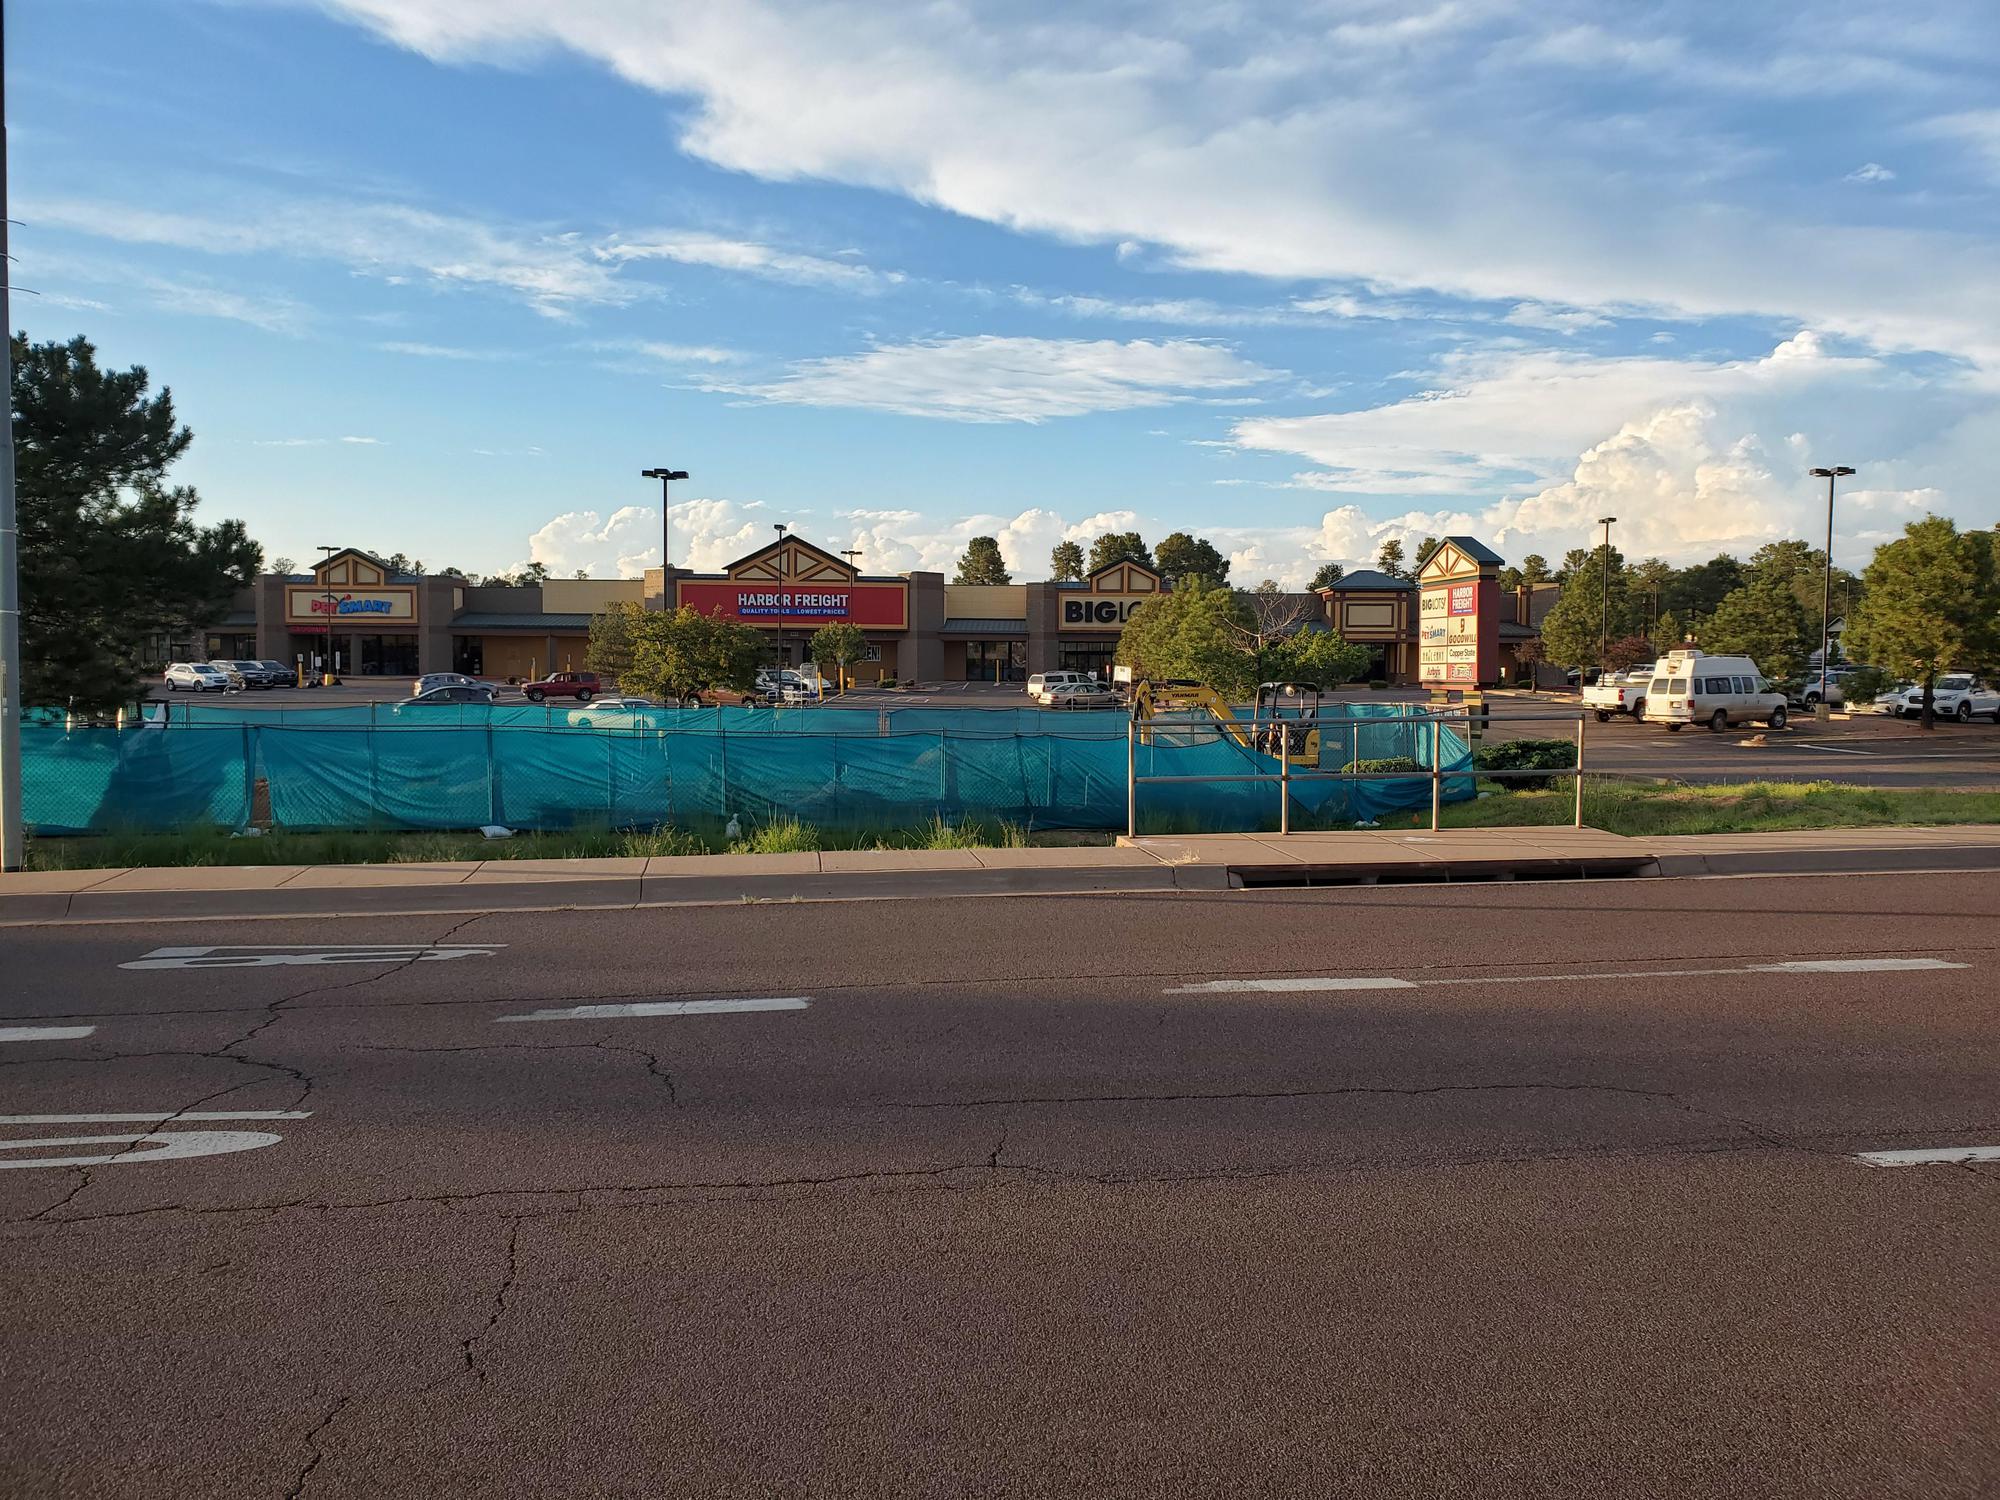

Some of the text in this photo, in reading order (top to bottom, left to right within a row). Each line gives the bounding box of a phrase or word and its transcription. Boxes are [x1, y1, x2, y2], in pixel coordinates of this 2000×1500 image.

[1452, 587, 1473, 599] HARBOR
[738, 593, 849, 607] HARBOR FREIGHT
[1452, 598, 1473, 610] FREIGHT
[1448, 634, 1477, 644] GOODWILL
